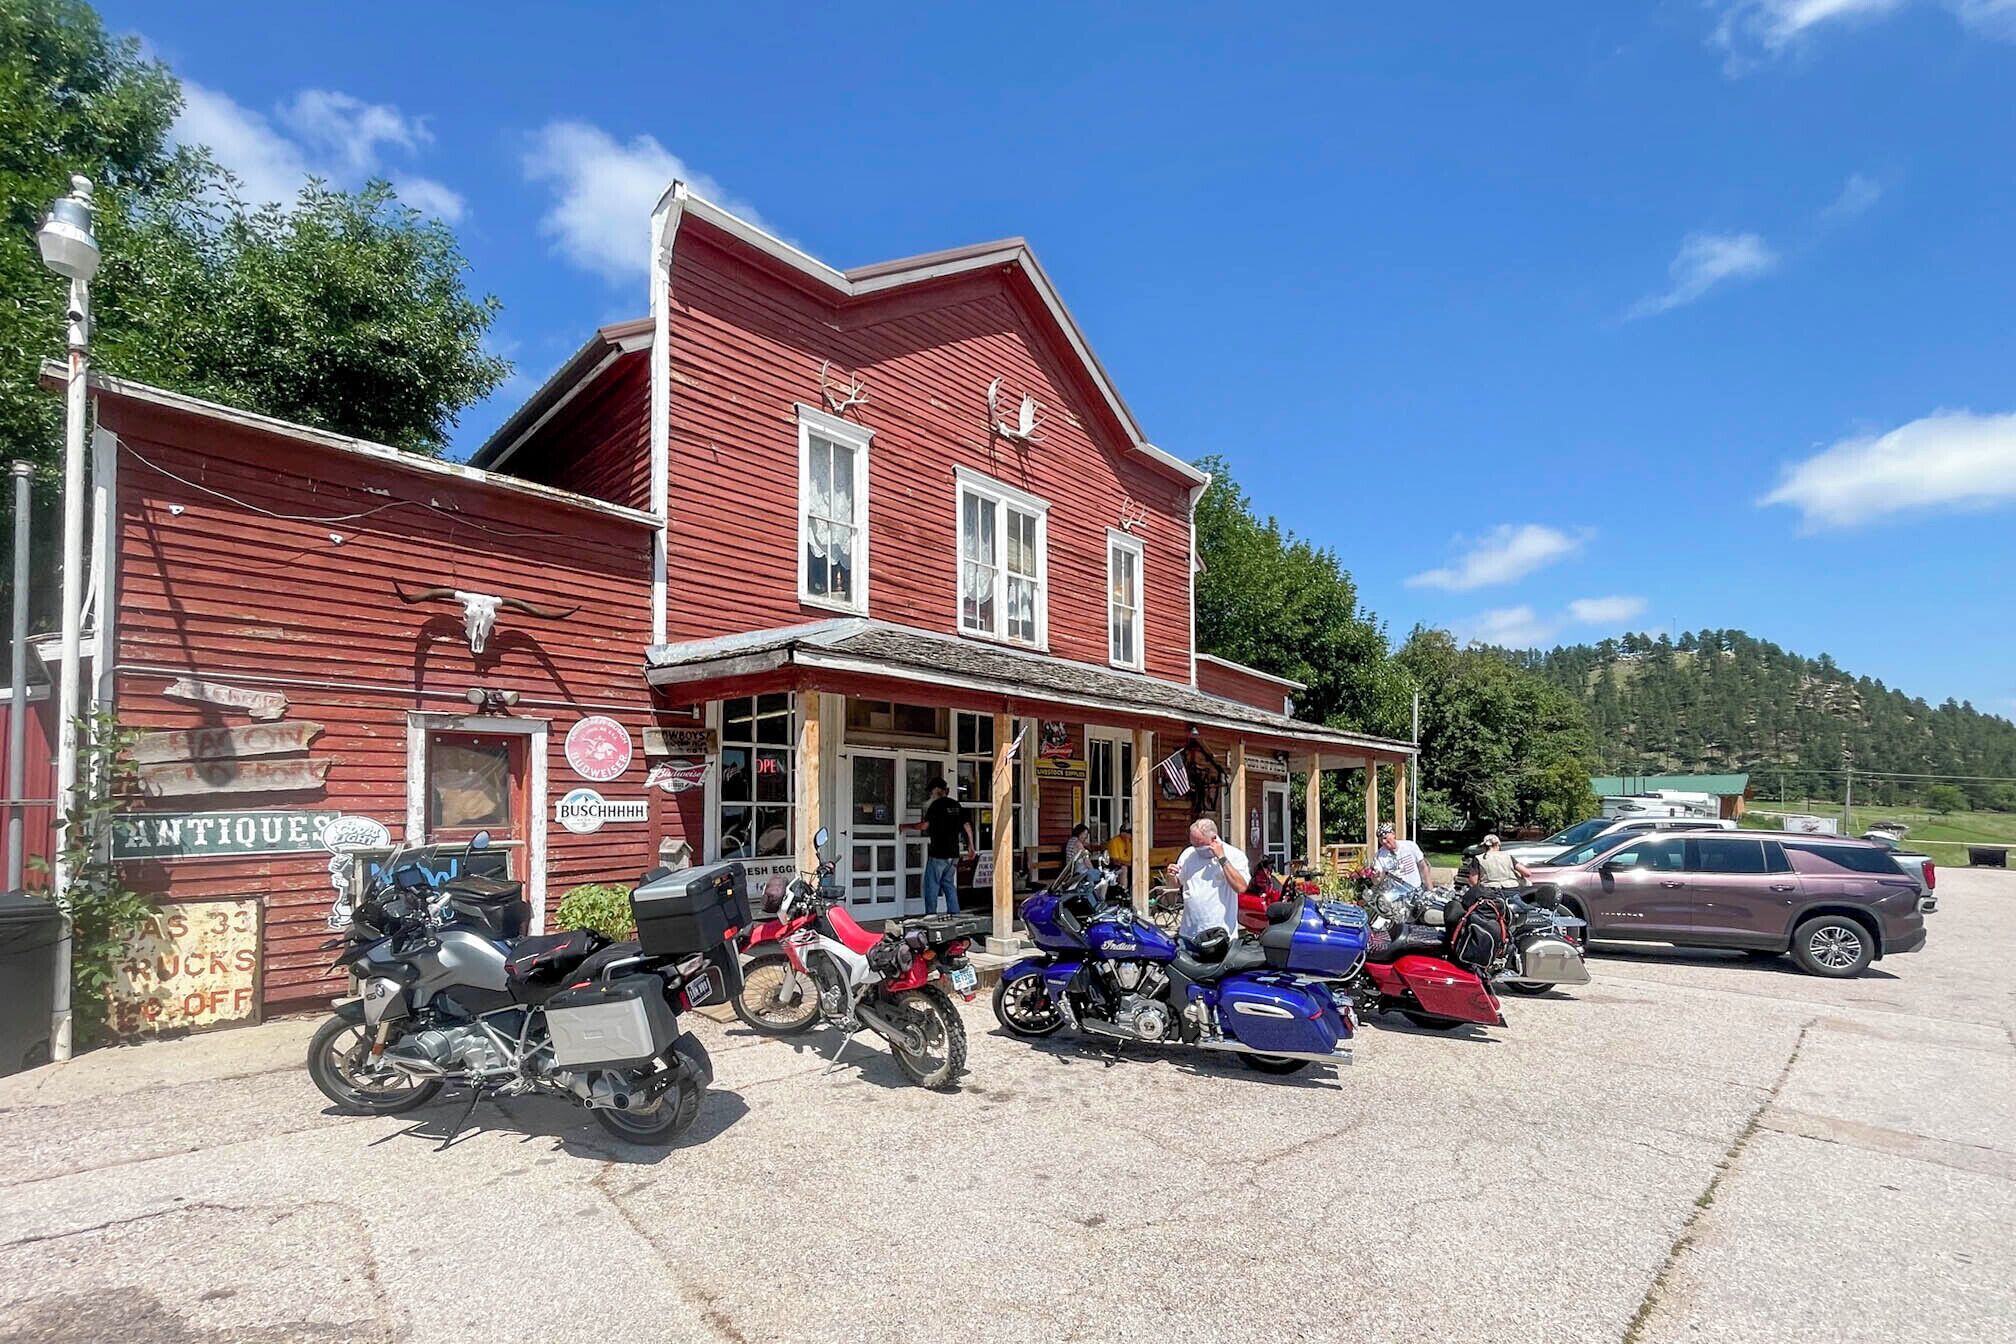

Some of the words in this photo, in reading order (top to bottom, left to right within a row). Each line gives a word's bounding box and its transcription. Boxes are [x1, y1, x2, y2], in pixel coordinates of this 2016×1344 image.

[570, 752, 628, 778] BUDWEISER
[755, 758, 786, 774] OPEN
[561, 804, 644, 818] BUSCHHHHH
[125, 815, 331, 848] ANTIQUES
[744, 867, 768, 876] ESH
[121, 914, 189, 941] AS
[1101, 940, 1137, 951] Indian
[184, 987, 253, 1017] OFF
